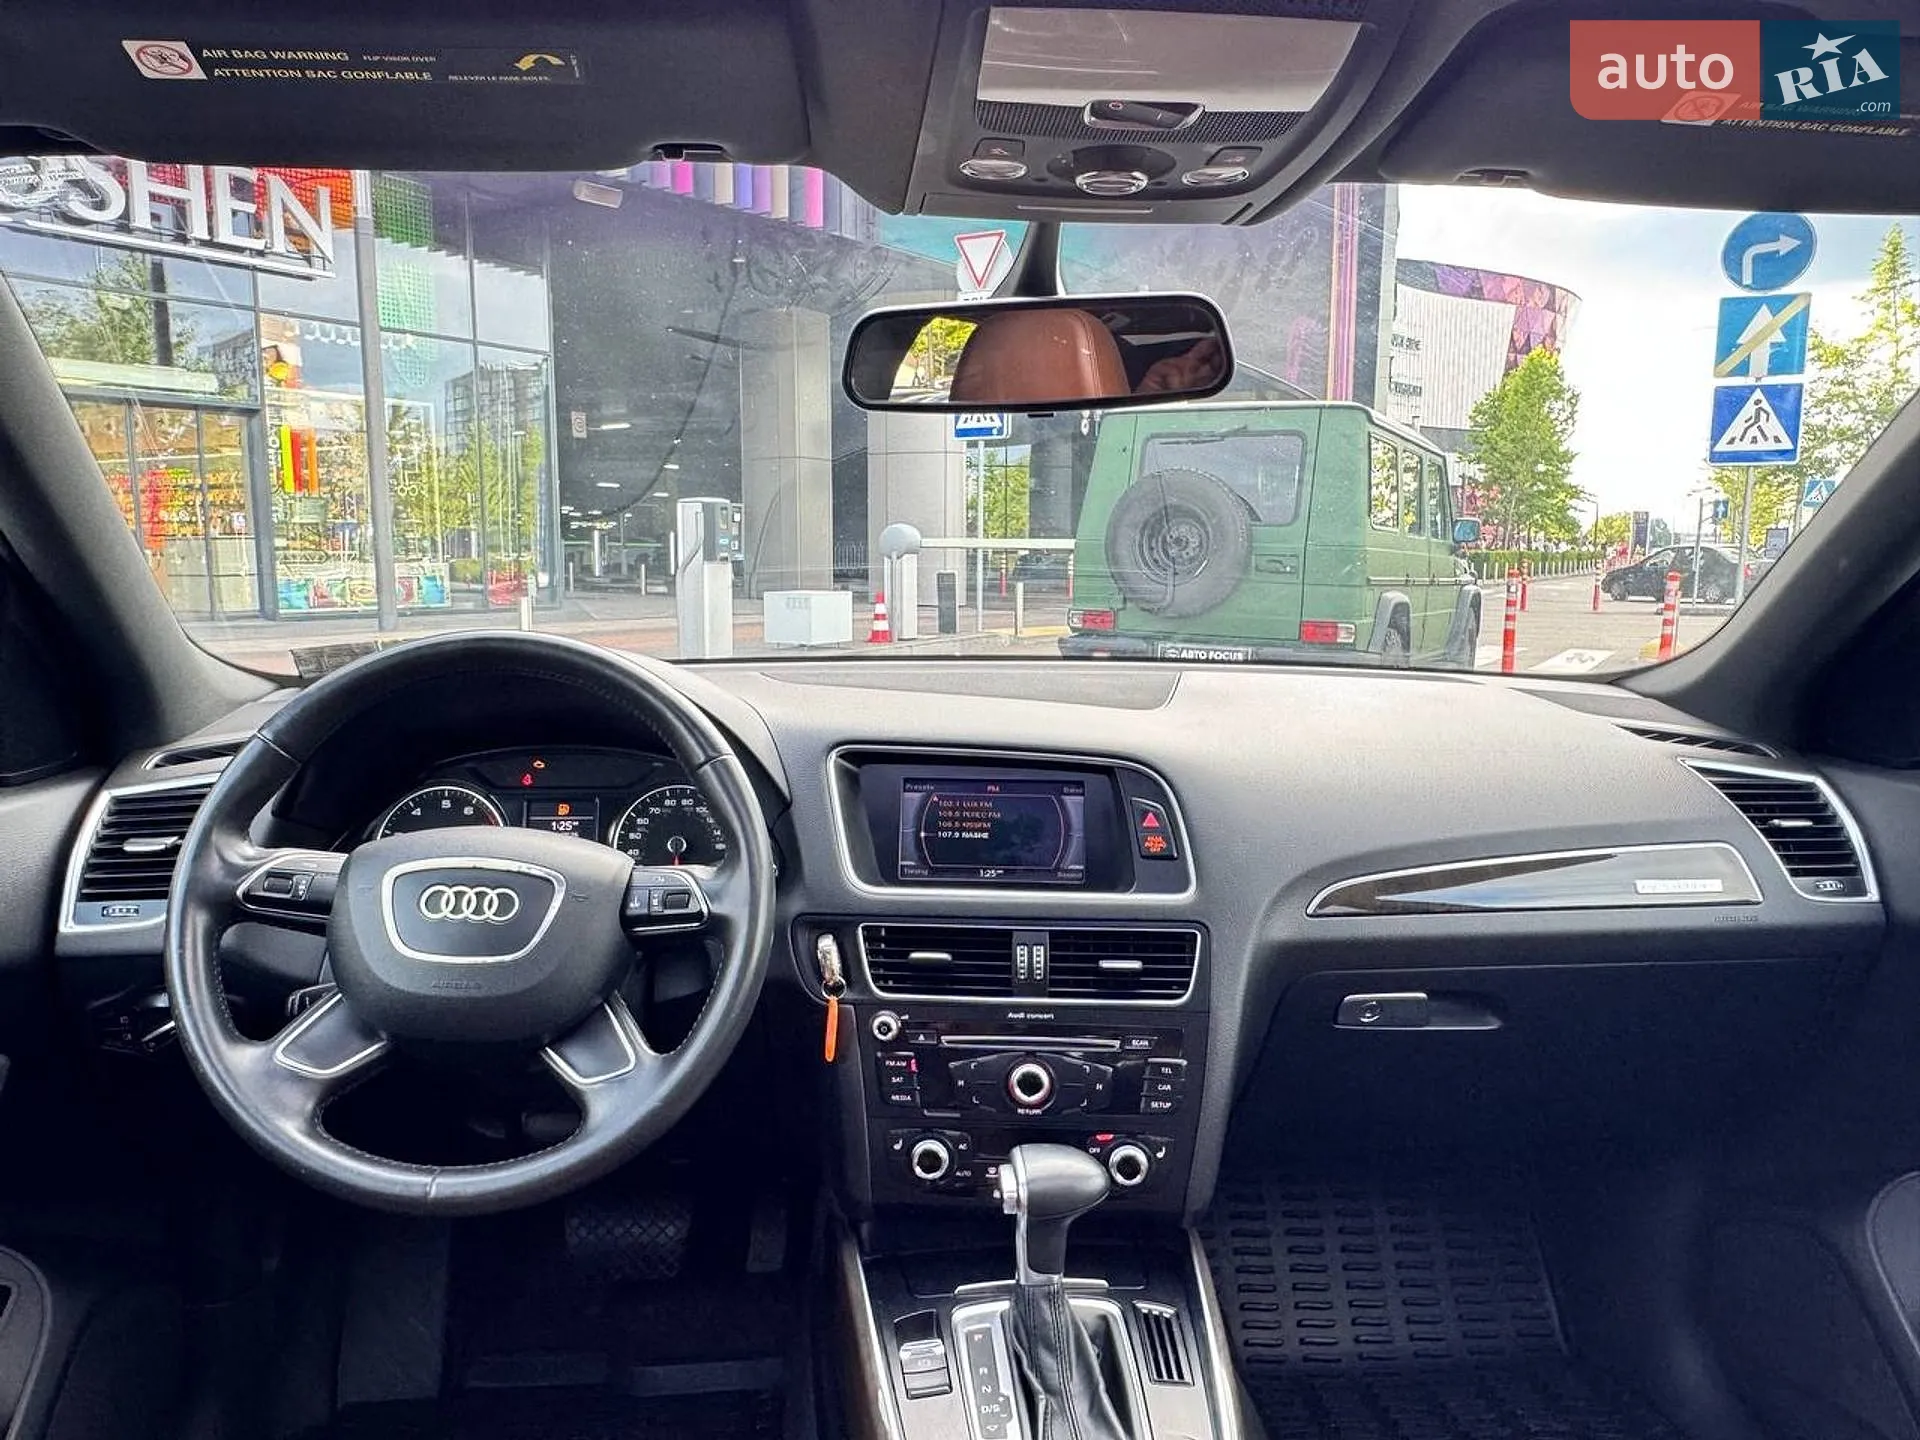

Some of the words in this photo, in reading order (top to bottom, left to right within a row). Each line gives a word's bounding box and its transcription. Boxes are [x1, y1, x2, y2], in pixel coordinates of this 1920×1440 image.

[202, 49, 229, 59] AIR
[231, 49, 267, 60] BAG
[269, 50, 348, 61] WARNING
[214, 68, 302, 78] ATTENTION
[304, 69, 338, 79] SAC
[340, 70, 433, 81] GONFLABLE
[411, 807, 422, 816] 4
[463, 806, 475, 816] 6
[648, 807, 661, 815] 70
[627, 848, 640, 856] 40
[1008, 1011, 1026, 1019] Audi
[1026, 1012, 1055, 1020] concert
